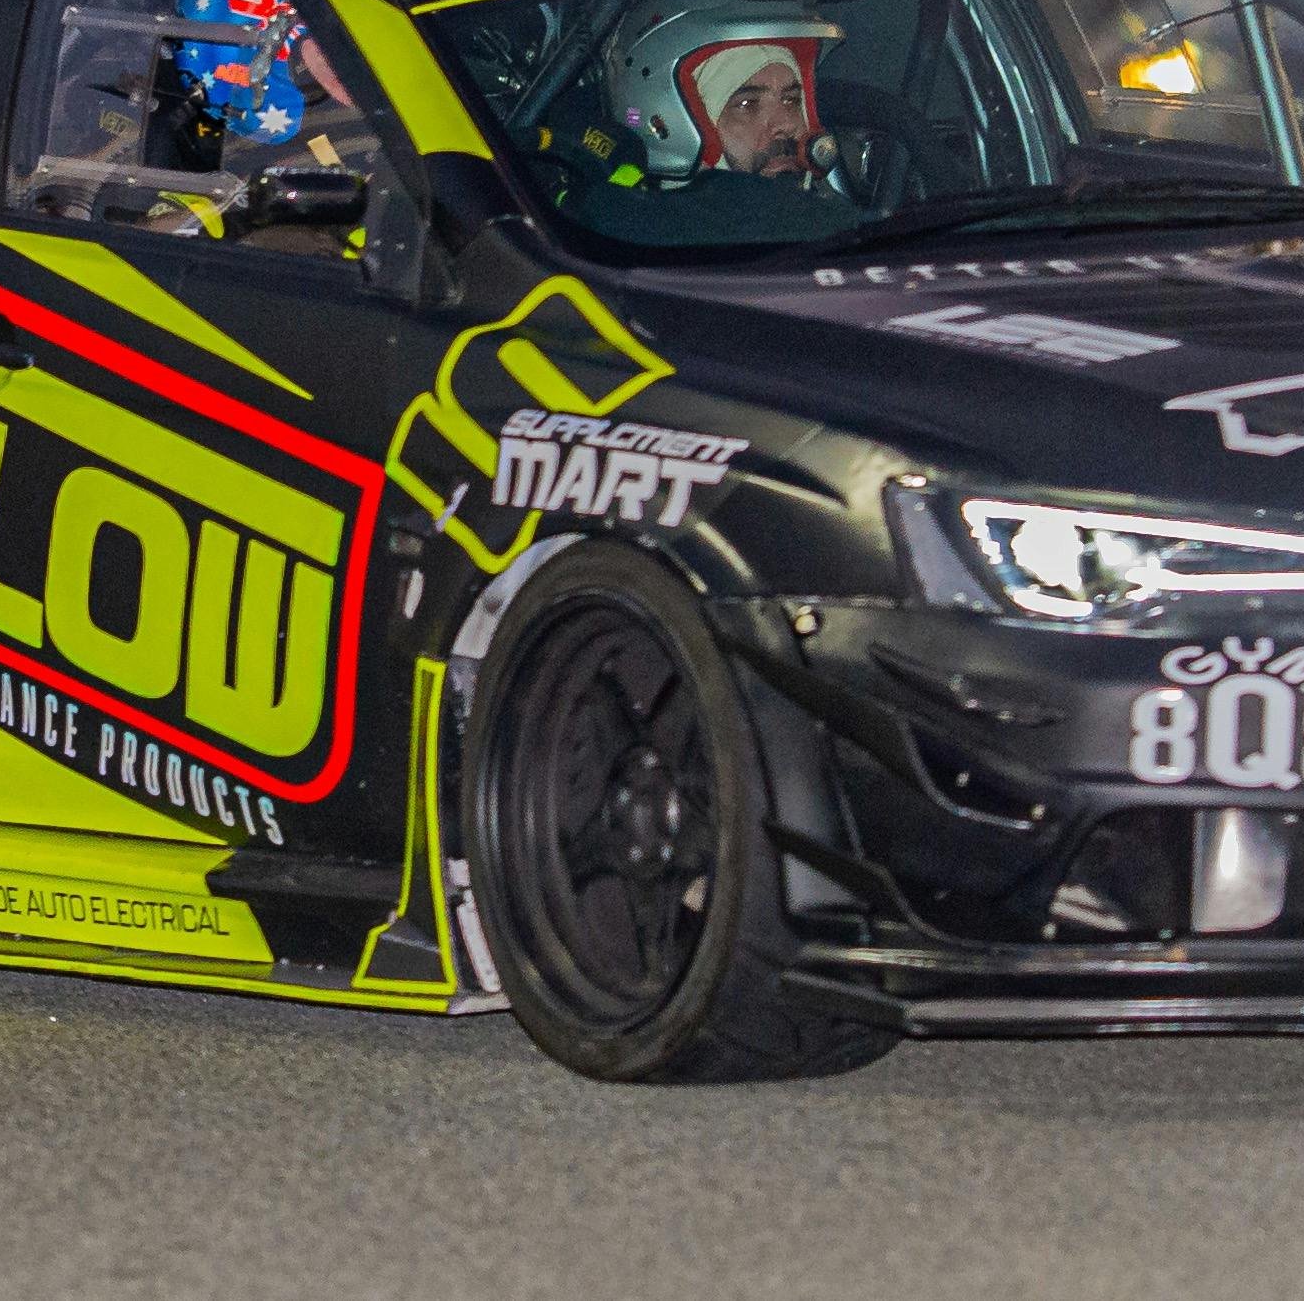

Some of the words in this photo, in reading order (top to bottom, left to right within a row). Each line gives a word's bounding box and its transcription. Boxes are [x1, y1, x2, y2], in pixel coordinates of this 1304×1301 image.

[501, 408, 750, 465] SUPPLEMENT
[491, 437, 730, 527] MART
[98, 722, 285, 847] PRODUCTS
[27, 889, 87, 922] AUTO
[91, 896, 231, 937] ELECTRICAL
